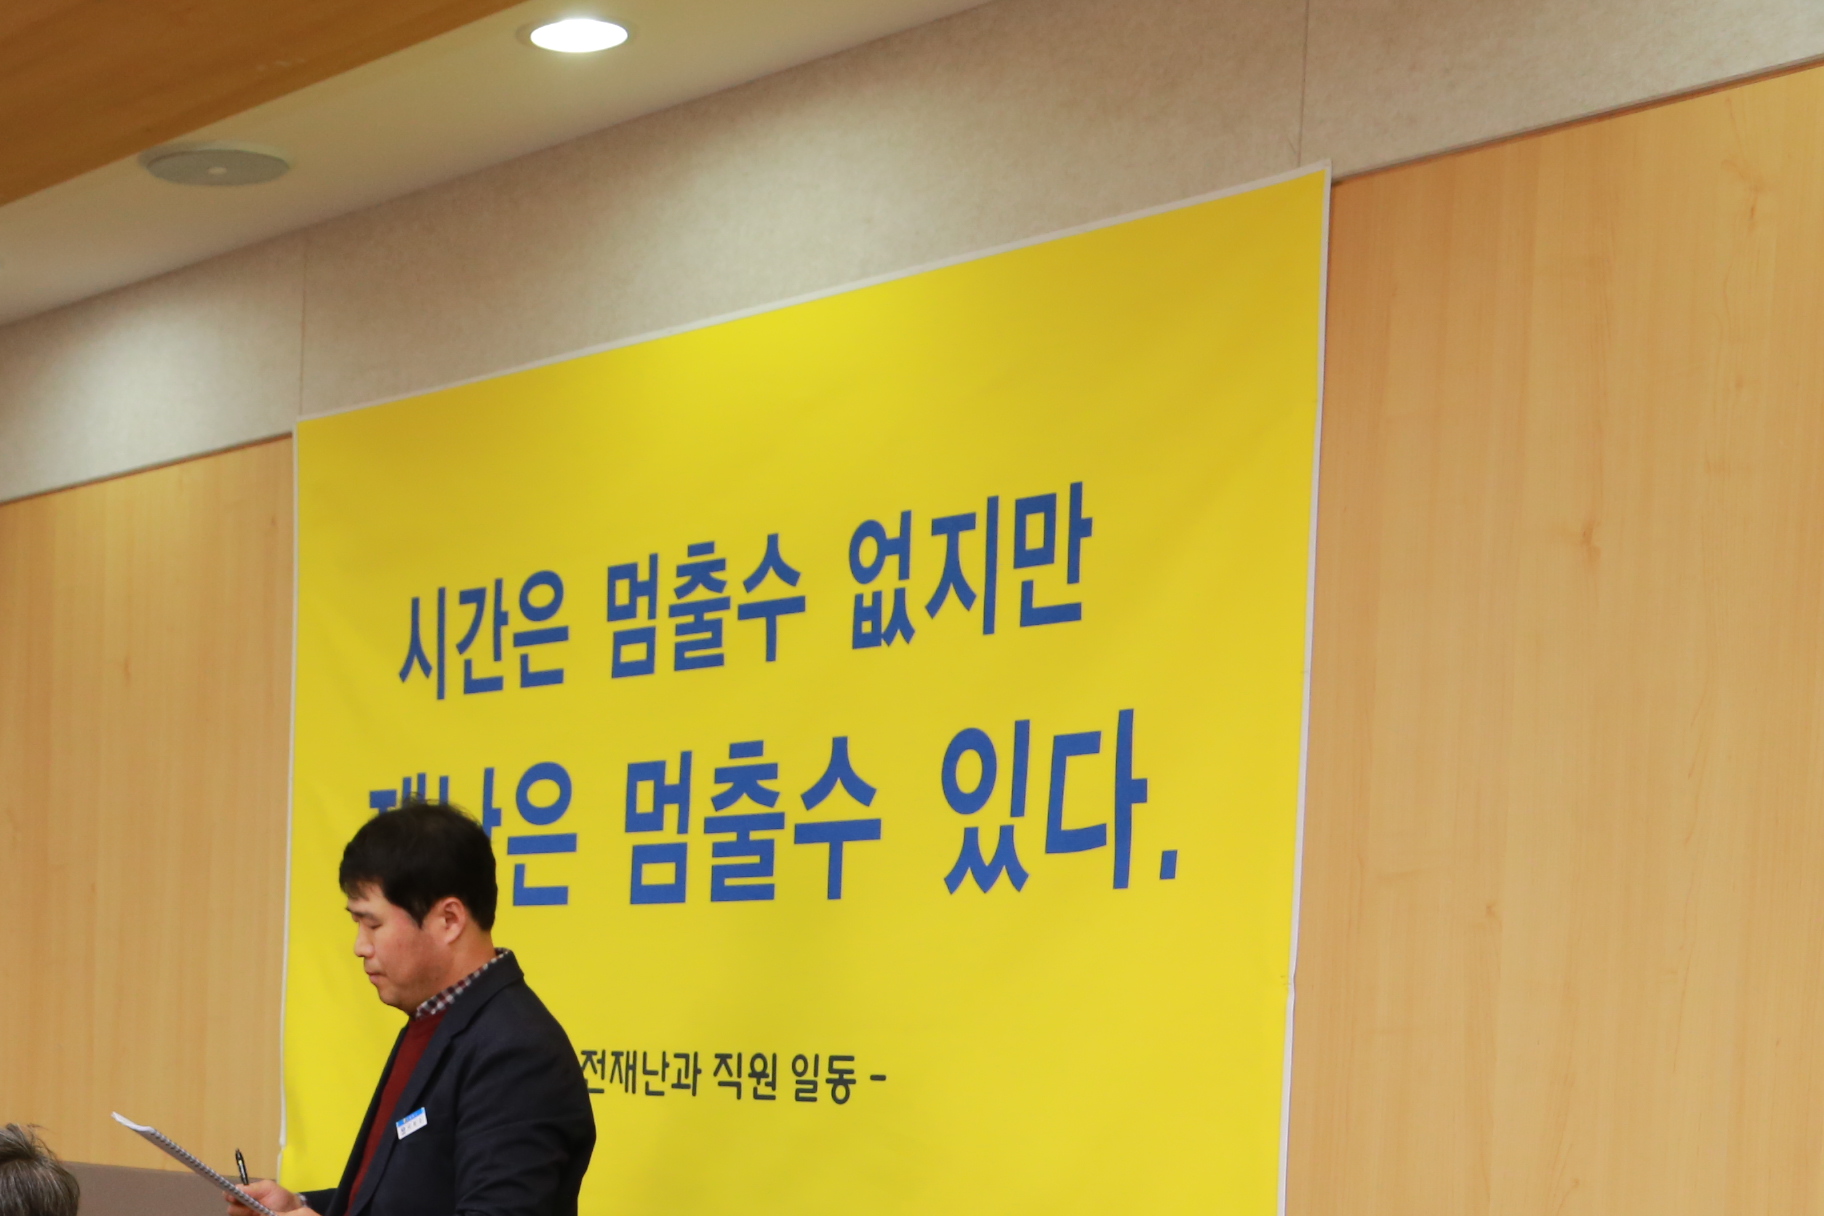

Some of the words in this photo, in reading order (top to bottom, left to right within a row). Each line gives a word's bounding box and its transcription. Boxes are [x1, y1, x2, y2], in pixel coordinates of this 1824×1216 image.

[398, 569, 570, 700] 시간은
[606, 532, 806, 679] 멈출수
[848, 481, 1094, 650] 없지만
[623, 735, 882, 905] 멈출수
[941, 707, 1178, 893] 있다.
[712, 1051, 778, 1101] 직원
[791, 1053, 857, 1105] 일동
